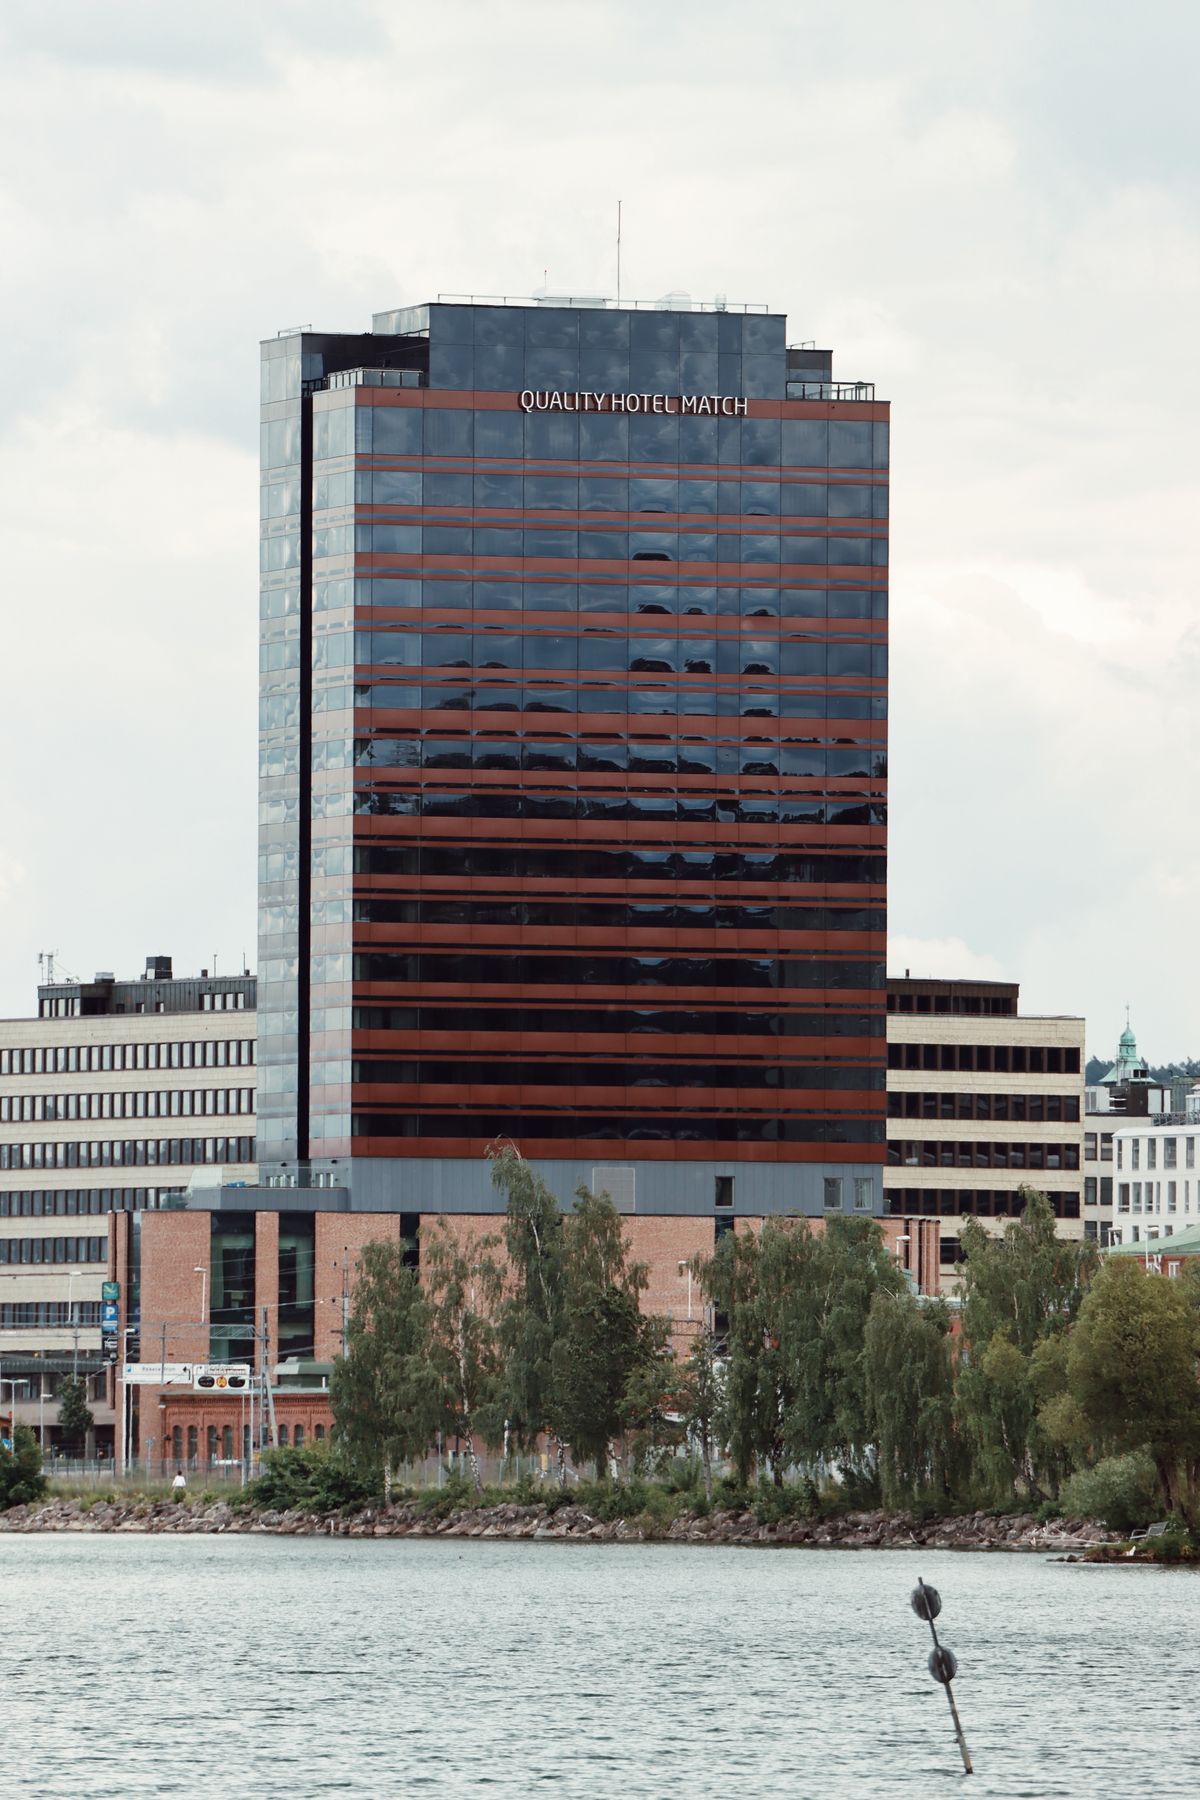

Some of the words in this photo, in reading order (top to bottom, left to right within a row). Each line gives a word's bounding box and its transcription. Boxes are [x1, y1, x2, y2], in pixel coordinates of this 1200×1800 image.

[521, 390, 605, 412] QUALITY
[611, 393, 675, 413] HOTEL
[682, 395, 748, 415] MATCH
[105, 1306, 115, 1319] P
